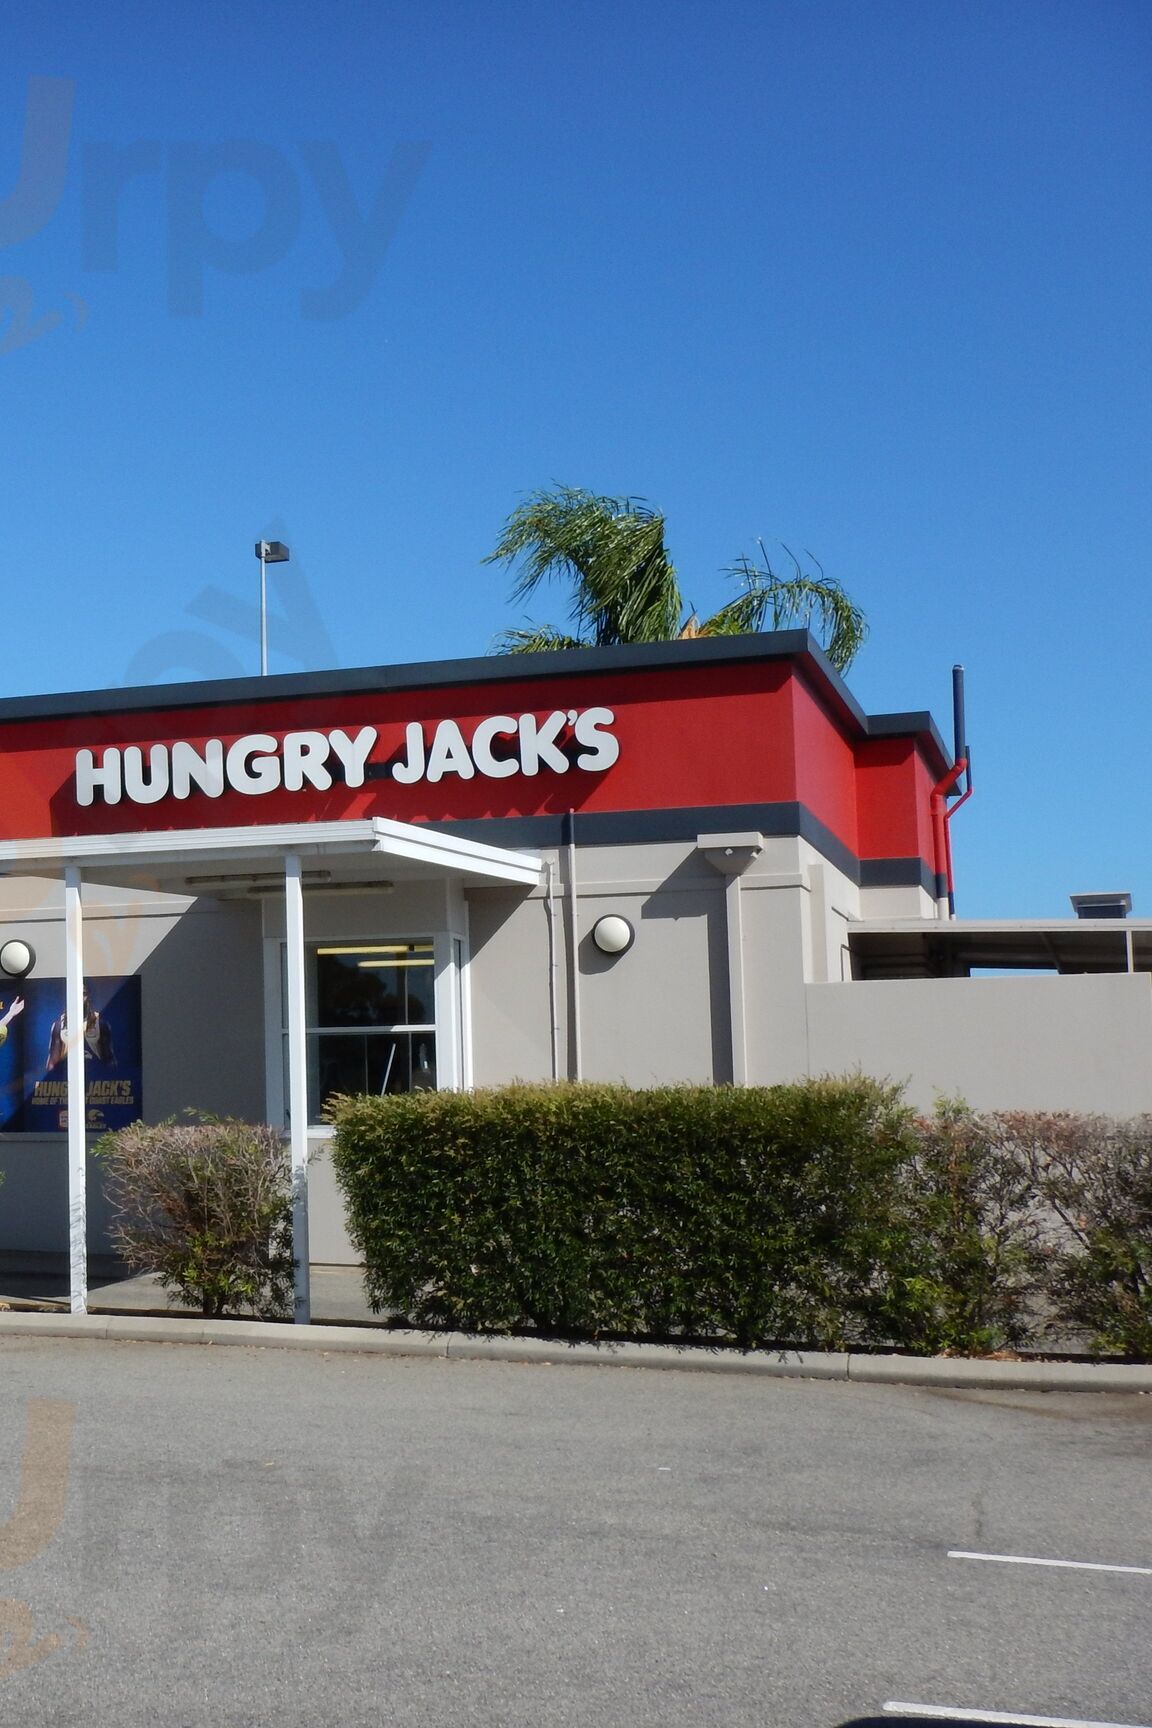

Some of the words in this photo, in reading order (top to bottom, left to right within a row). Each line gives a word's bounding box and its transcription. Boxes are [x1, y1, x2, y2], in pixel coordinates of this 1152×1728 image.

[74, 725, 378, 807] HUNGRY
[391, 706, 620, 784] JACK'S
[34, 1081, 69, 1097] HUNG
[86, 1080, 131, 1097] JACK'S
